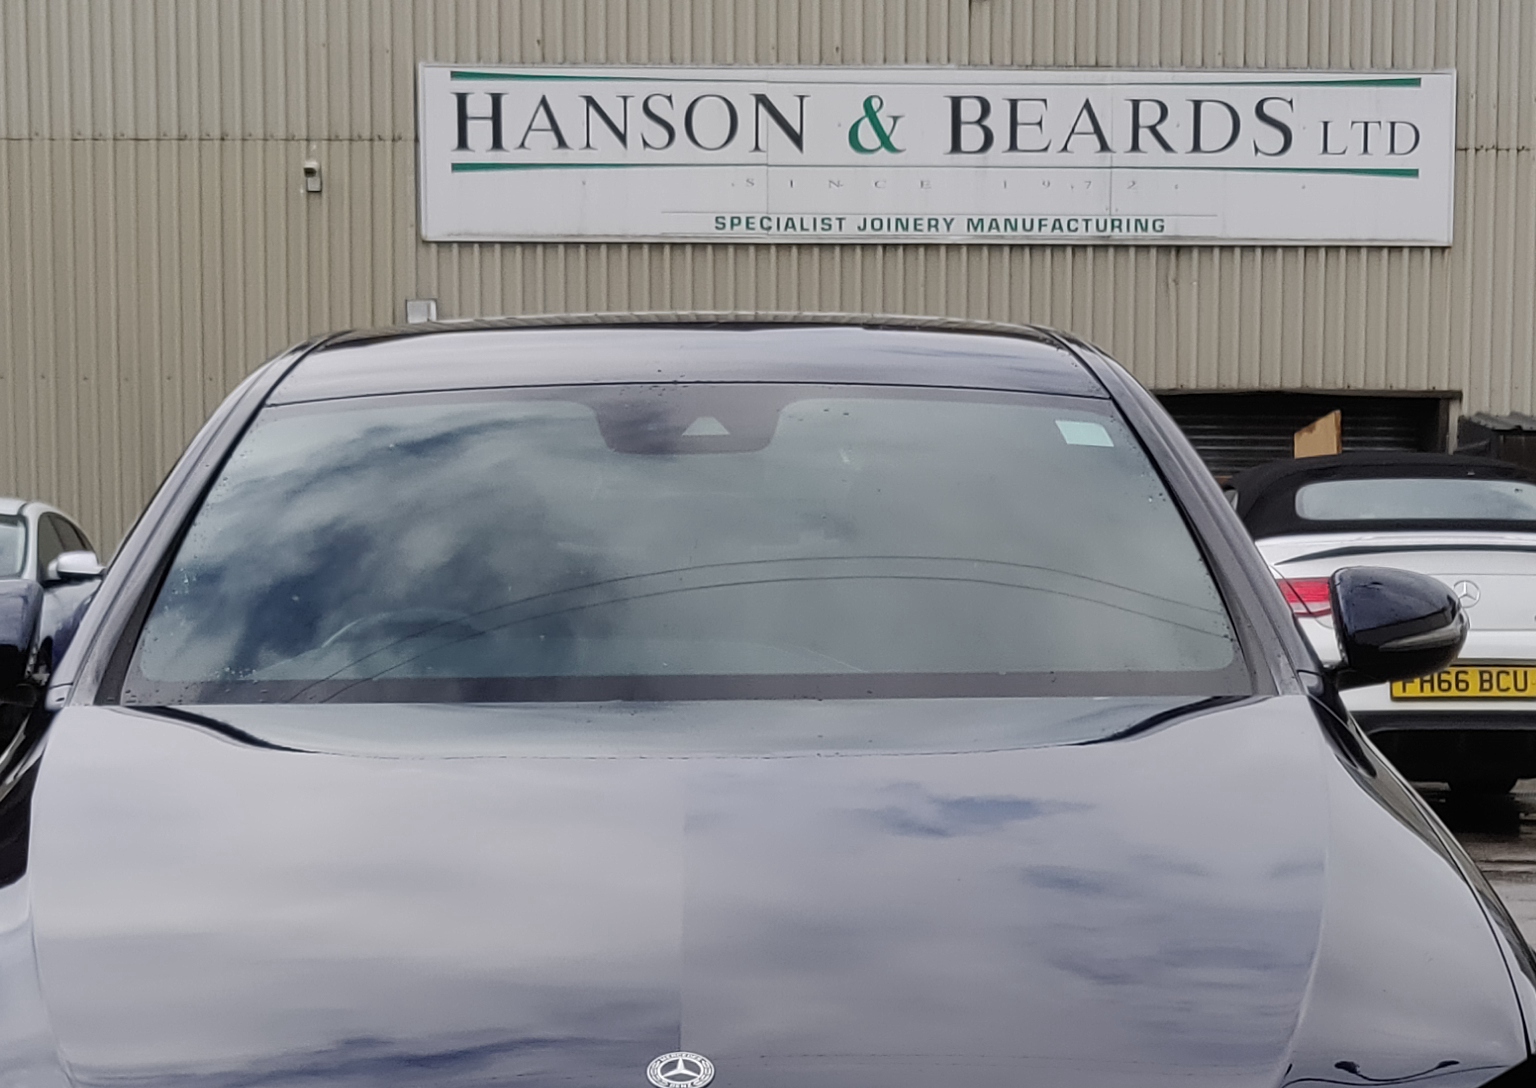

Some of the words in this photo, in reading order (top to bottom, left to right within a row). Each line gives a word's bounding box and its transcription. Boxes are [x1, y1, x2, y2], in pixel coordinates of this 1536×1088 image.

[451, 91, 811, 155] HANSON
[848, 94, 906, 155] &
[943, 95, 1295, 157] BEARDS
[1318, 120, 1421, 156] LTD
[714, 216, 846, 233] SPECIALIST
[857, 216, 955, 233] JOINERY
[967, 216, 1165, 233] MANUFACTURING
[1479, 670, 1528, 693] BCU
